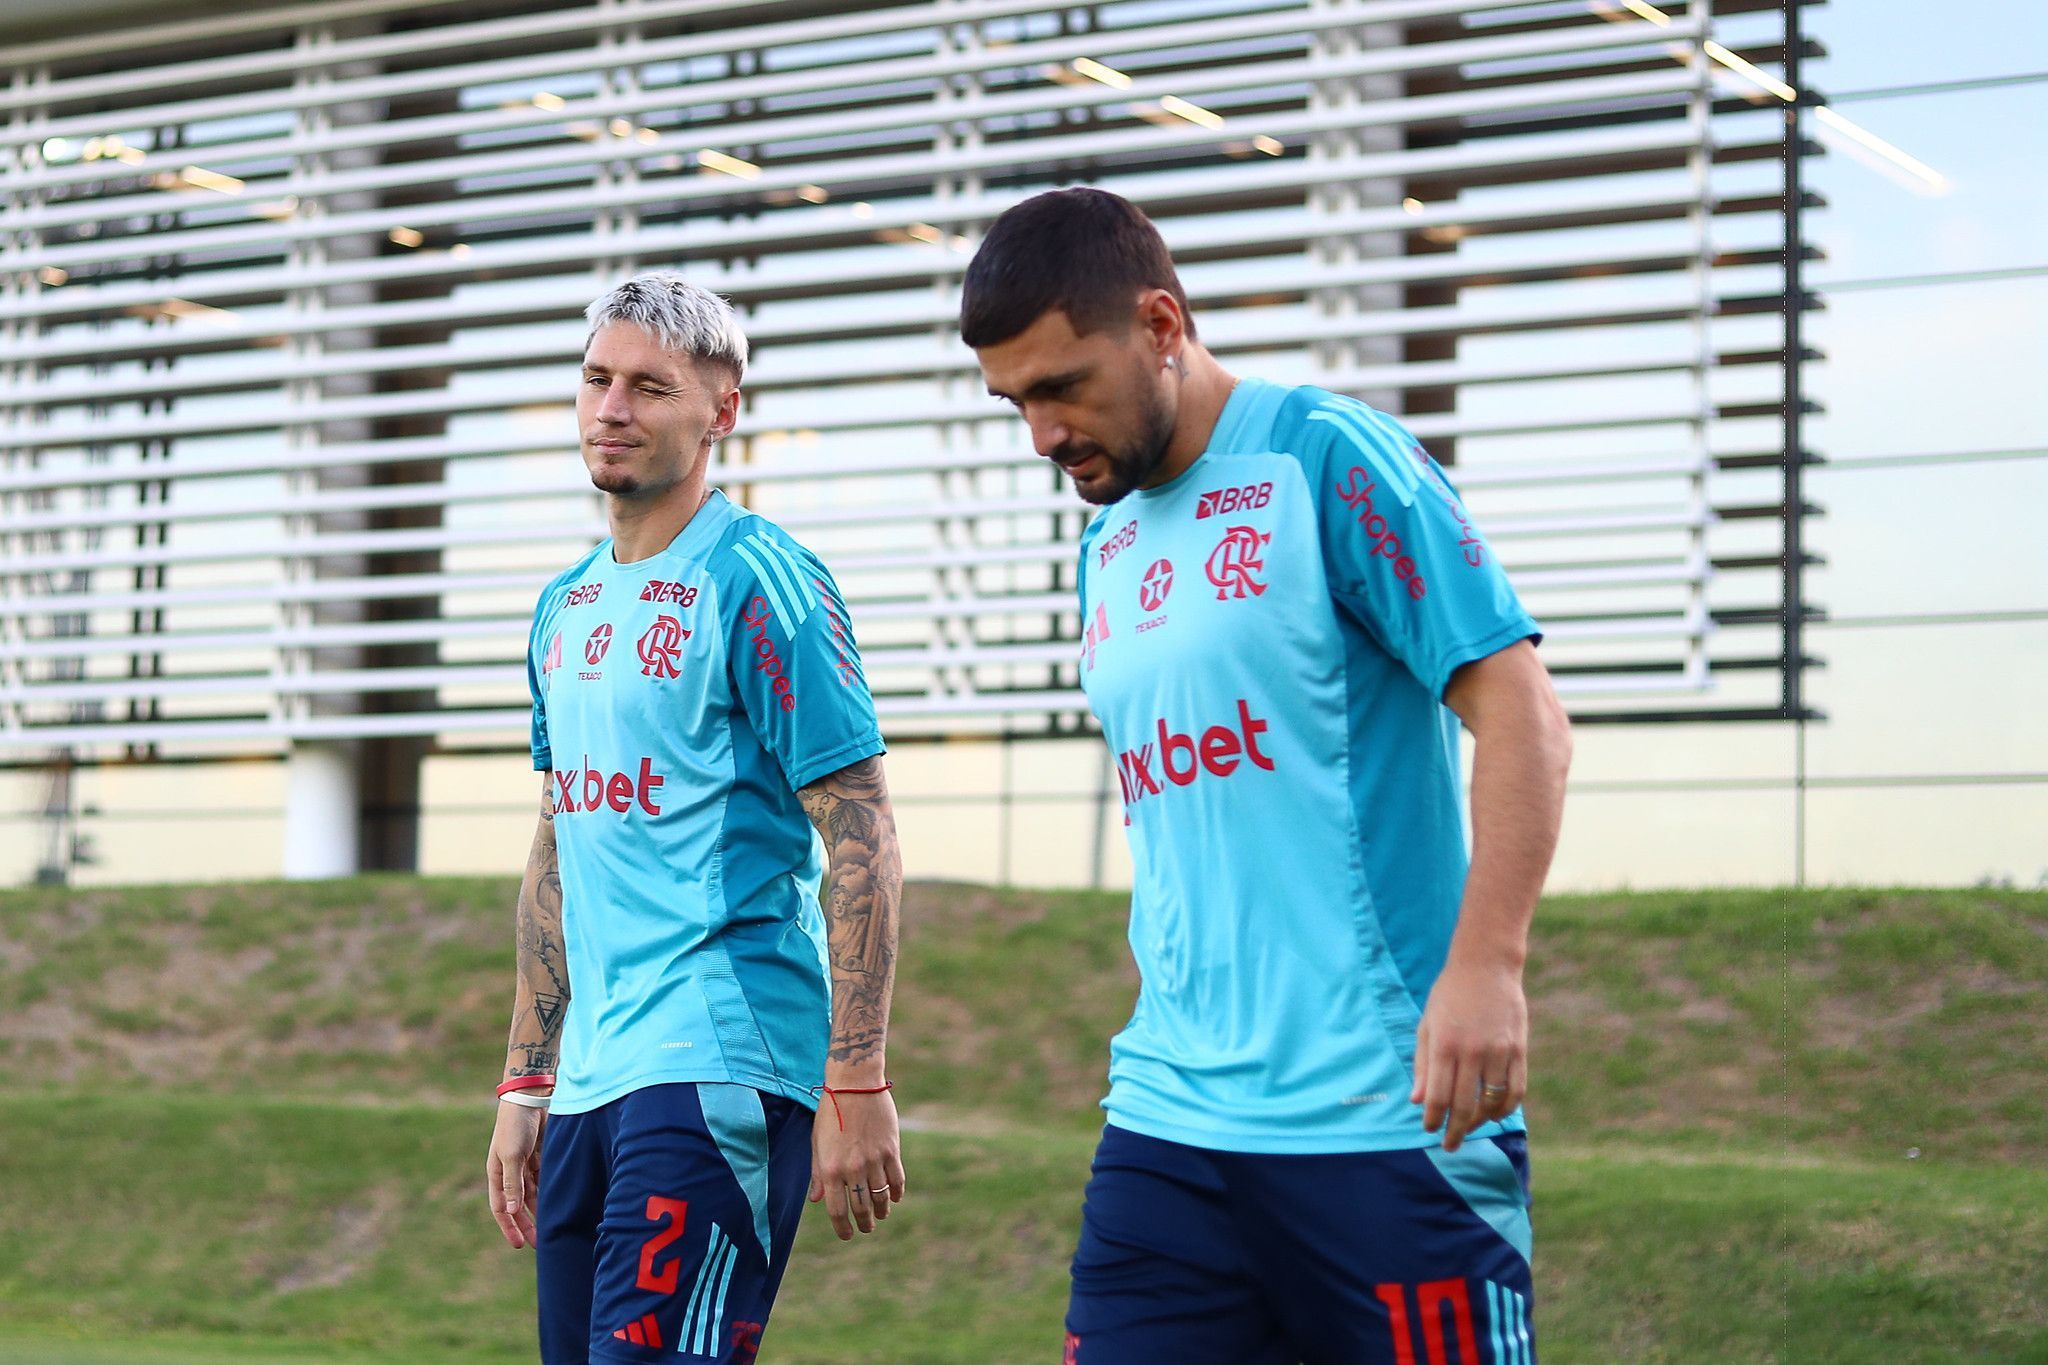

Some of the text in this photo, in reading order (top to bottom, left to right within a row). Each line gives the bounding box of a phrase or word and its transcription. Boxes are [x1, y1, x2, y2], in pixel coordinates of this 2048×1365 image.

[1220, 481, 1273, 515] BRB
[1109, 519, 1138, 561] BRB
[1335, 466, 1426, 601] Shopee
[571, 582, 603, 606] BRB
[1135, 615, 1168, 634] TEXACO
[742, 596, 797, 713] Shopee
[578, 671, 602, 681] TEXACO
[636, 1195, 688, 1294] 2
[1374, 1277, 1480, 1365] 10
